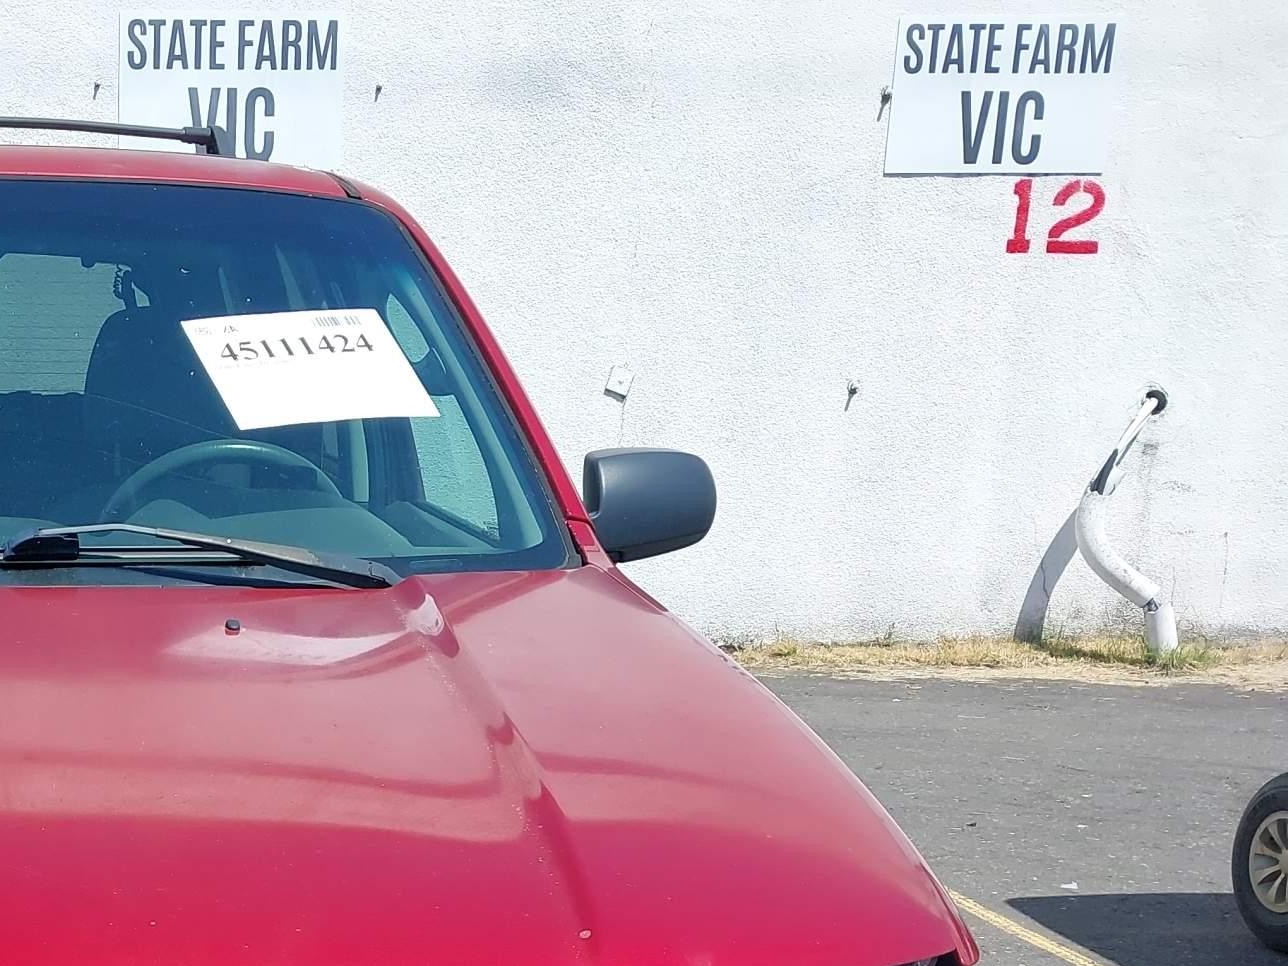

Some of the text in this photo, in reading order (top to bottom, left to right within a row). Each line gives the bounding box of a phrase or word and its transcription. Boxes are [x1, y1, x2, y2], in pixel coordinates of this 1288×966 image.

[127, 19, 339, 71] STATE FARM
[903, 22, 1117, 75] STATE FARM
[187, 87, 275, 162] VIC
[961, 90, 1045, 165] VIC
[1005, 178, 1106, 254] 12
[220, 333, 374, 361] 45111424
